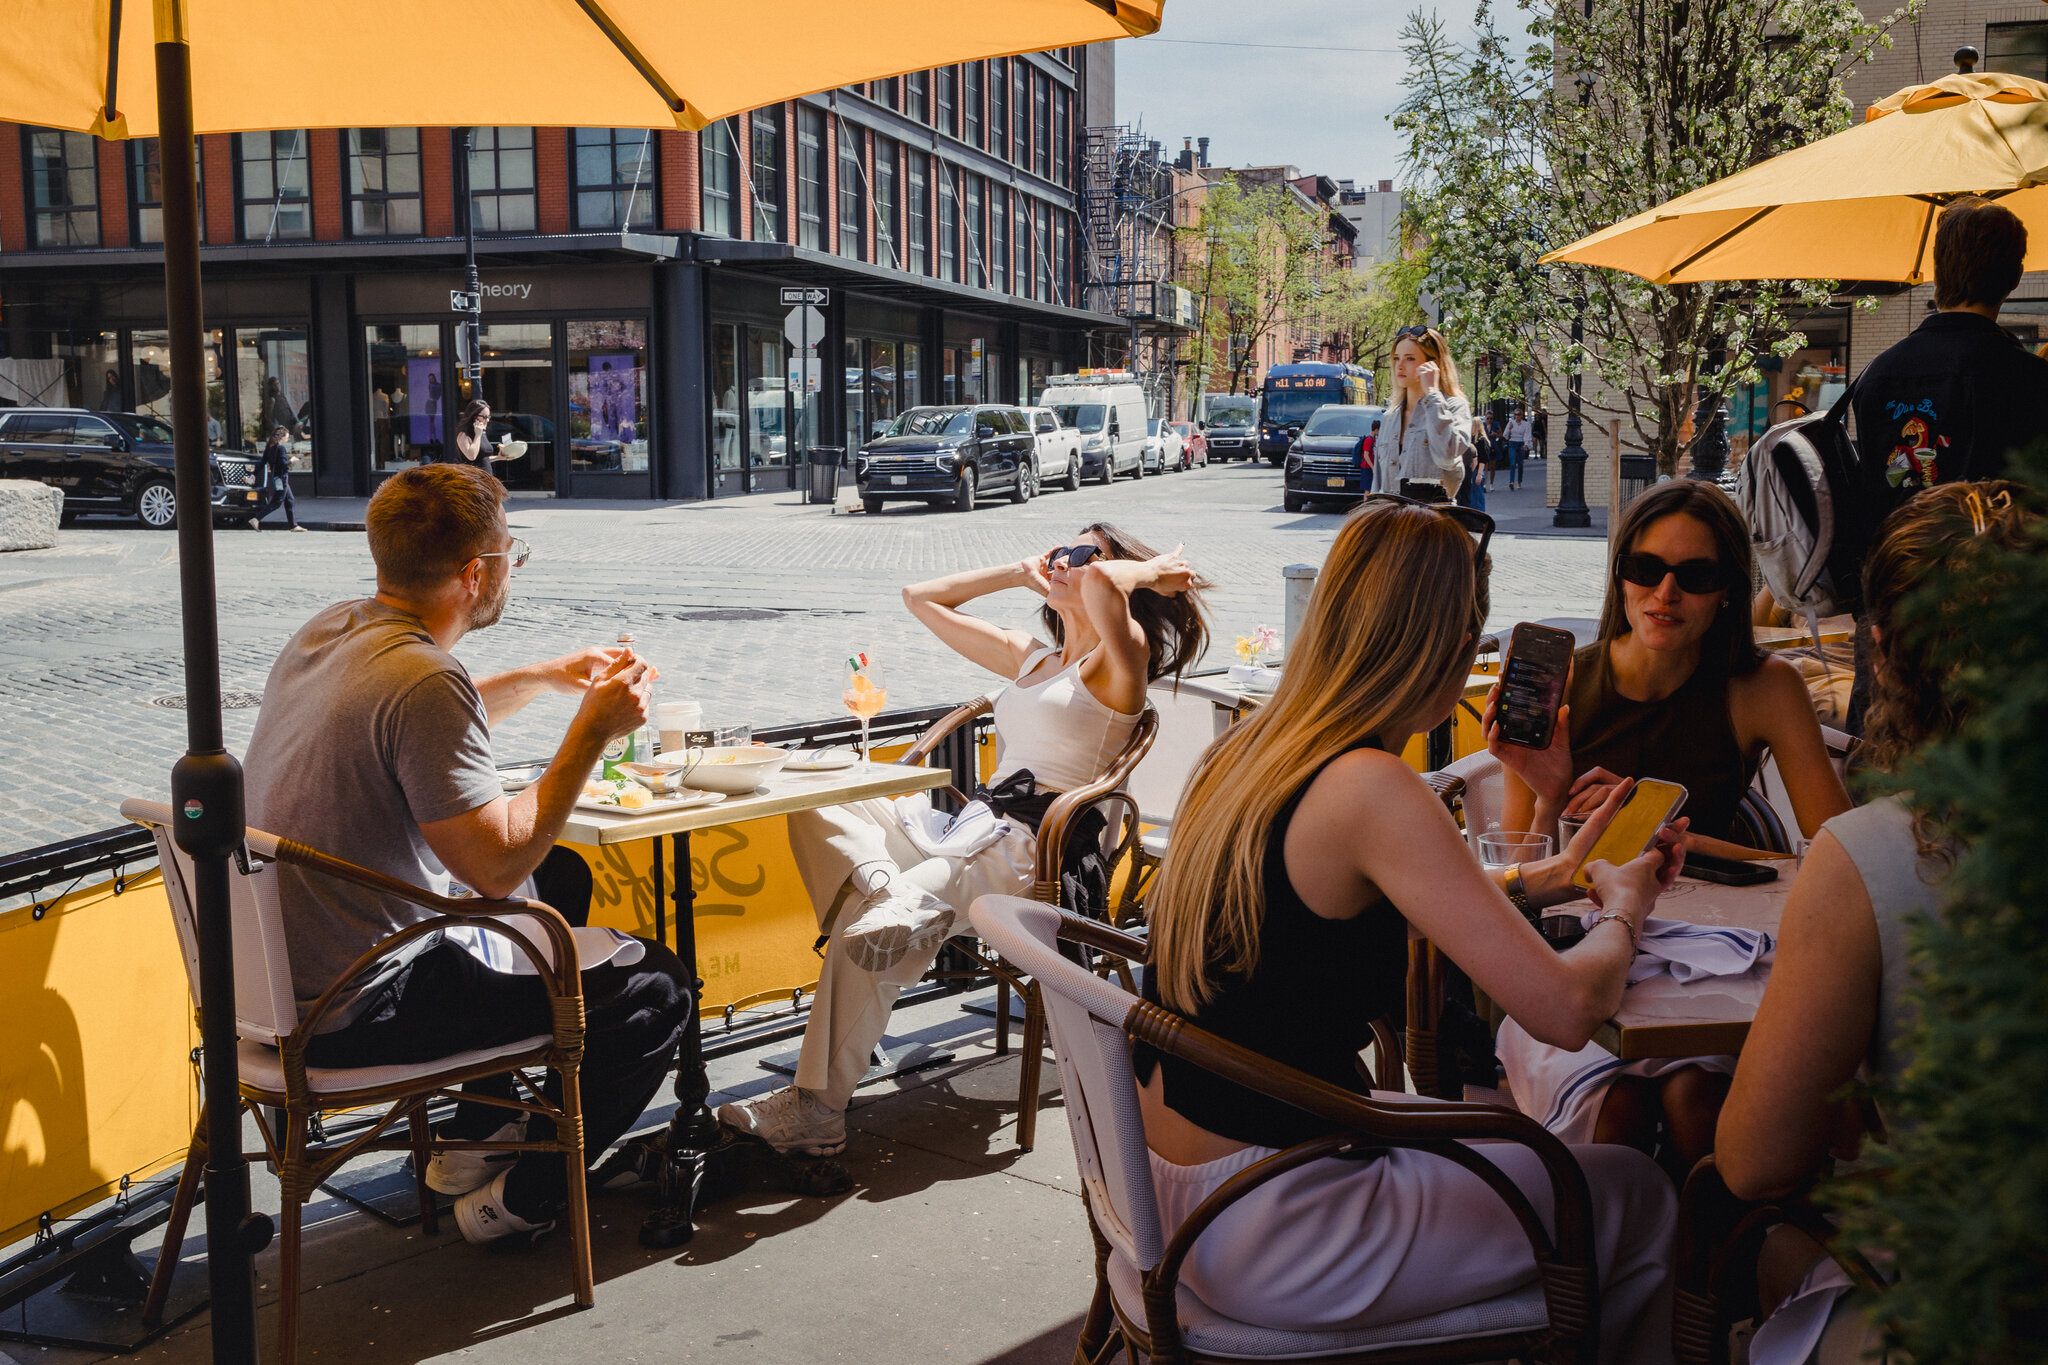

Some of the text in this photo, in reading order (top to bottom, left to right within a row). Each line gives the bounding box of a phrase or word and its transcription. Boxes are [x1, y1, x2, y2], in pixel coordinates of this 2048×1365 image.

[480, 282, 532, 299] heory
[1275, 378, 1289, 388] M11
[1304, 378, 1314, 388] 10
